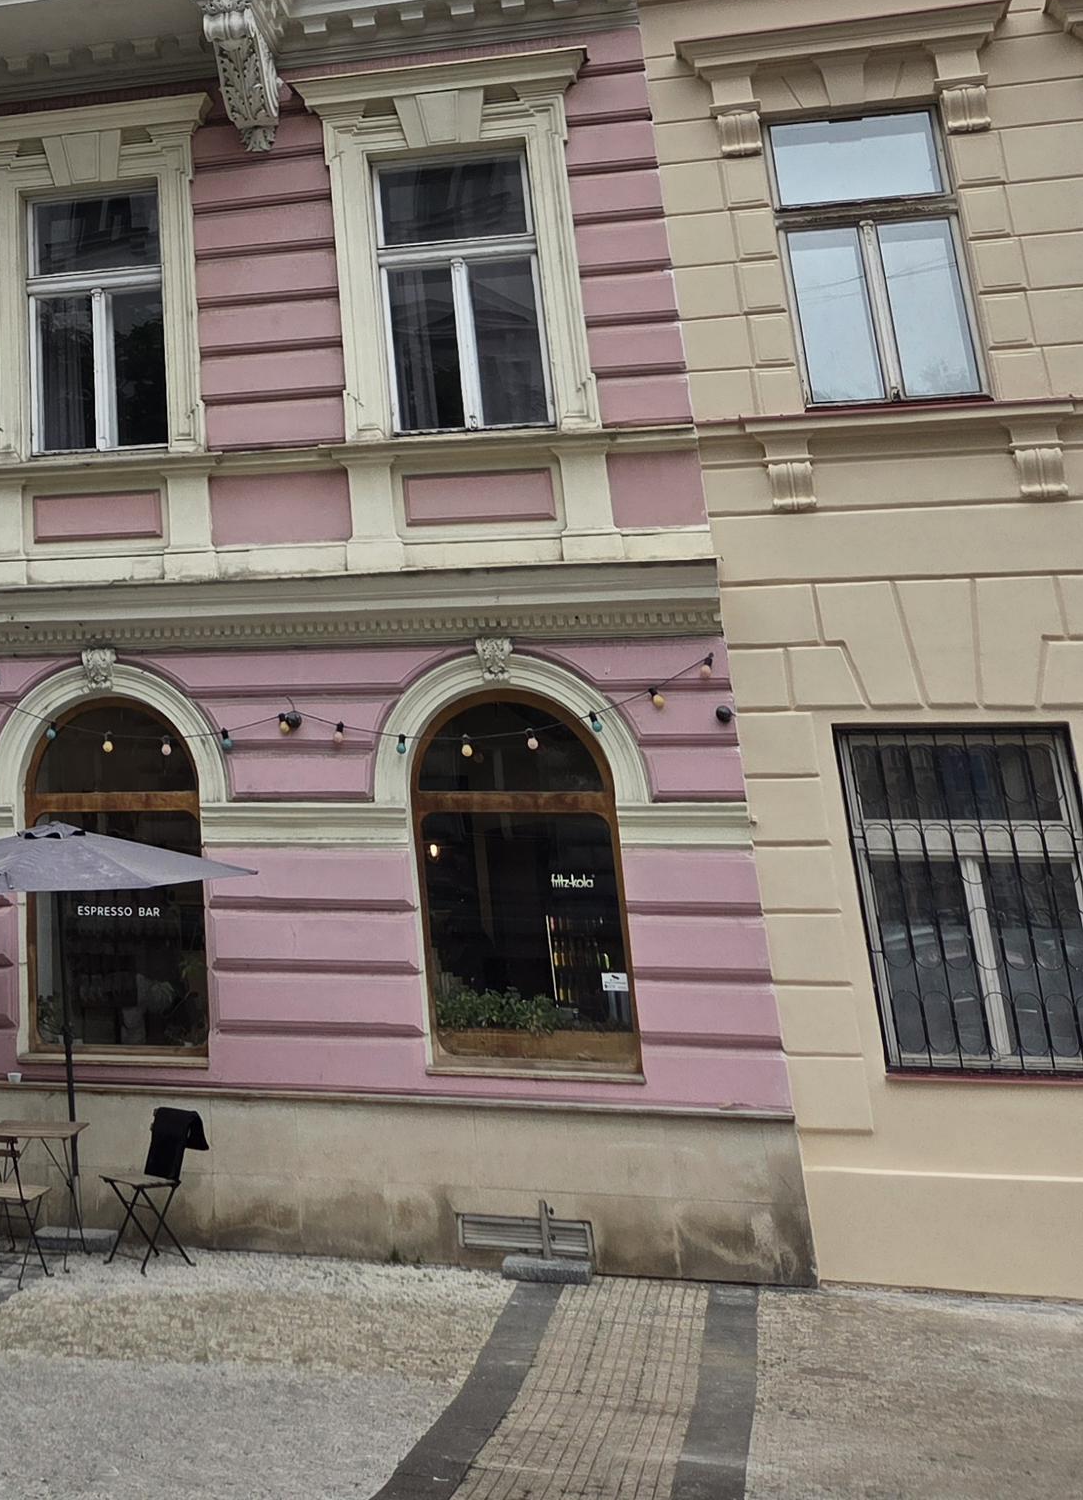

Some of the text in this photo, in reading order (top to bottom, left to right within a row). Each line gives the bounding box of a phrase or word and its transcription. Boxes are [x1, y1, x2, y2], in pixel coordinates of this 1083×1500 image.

[551, 873, 594, 888] fritz-kola
[77, 905, 160, 917] ESPRESSO BAR
